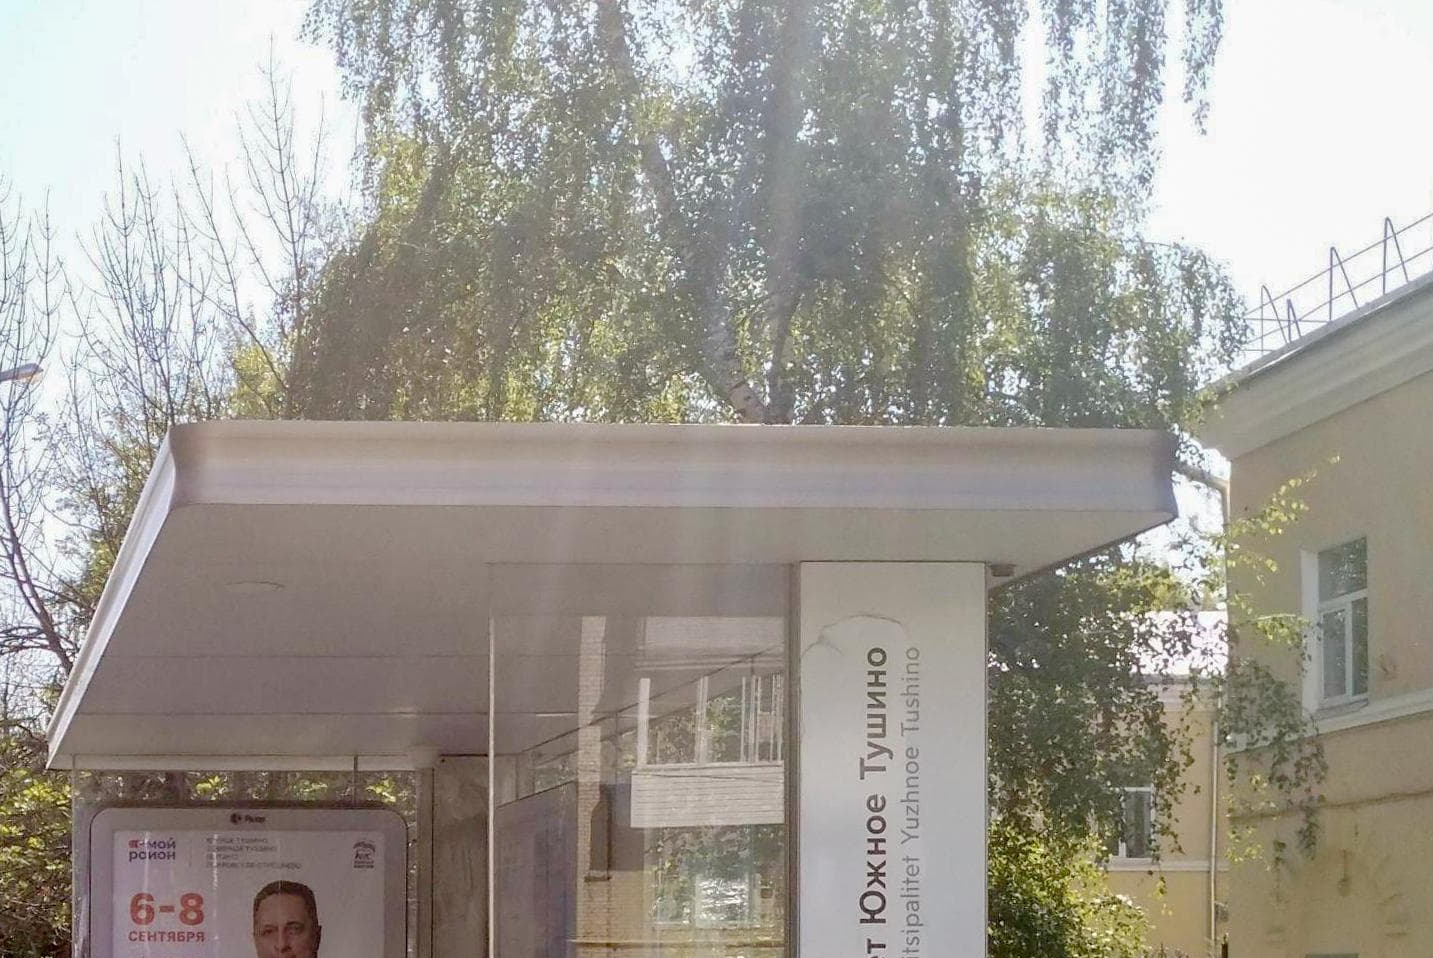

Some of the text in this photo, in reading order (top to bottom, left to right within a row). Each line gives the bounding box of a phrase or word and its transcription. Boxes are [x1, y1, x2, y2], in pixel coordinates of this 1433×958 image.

[859, 646, 894, 781] Тушино
[900, 647, 921, 737] Tushino
[900, 746, 921, 845] Yuzhnoe
[859, 793, 887, 924] Южное
[128, 930, 205, 943] СЕНТЯБРЯ
